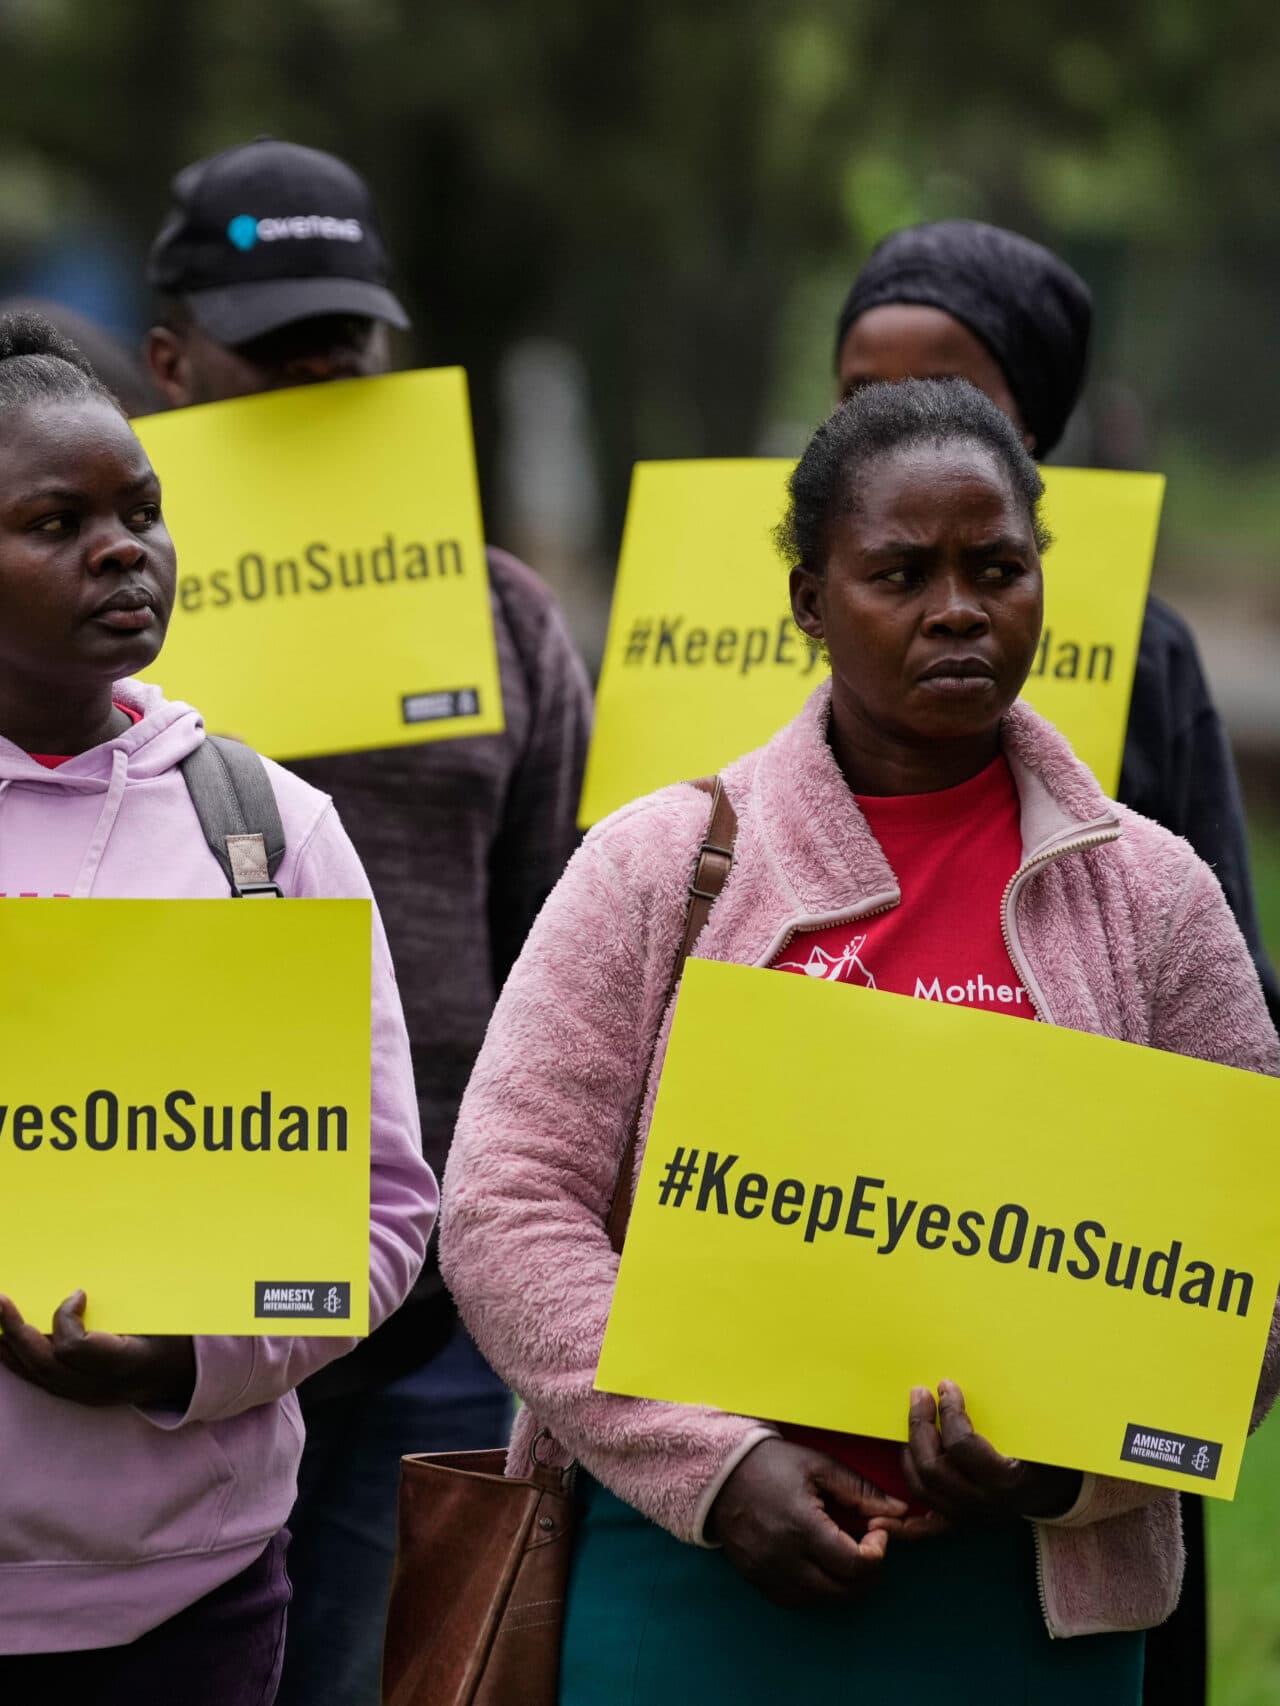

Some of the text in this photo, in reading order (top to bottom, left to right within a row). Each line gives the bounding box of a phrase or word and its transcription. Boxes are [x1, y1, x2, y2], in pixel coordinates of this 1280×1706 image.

[178, 533, 465, 612] esOnSudan
[658, 1146, 1255, 1317] #KeepEyesOnSudan
[263, 1288, 315, 1302] AMNESTY
[263, 1302, 314, 1311] INTERNATIONAL
[1132, 1433, 1186, 1456] AMNESTY
[1131, 1446, 1181, 1465] INTERNATIONAL
